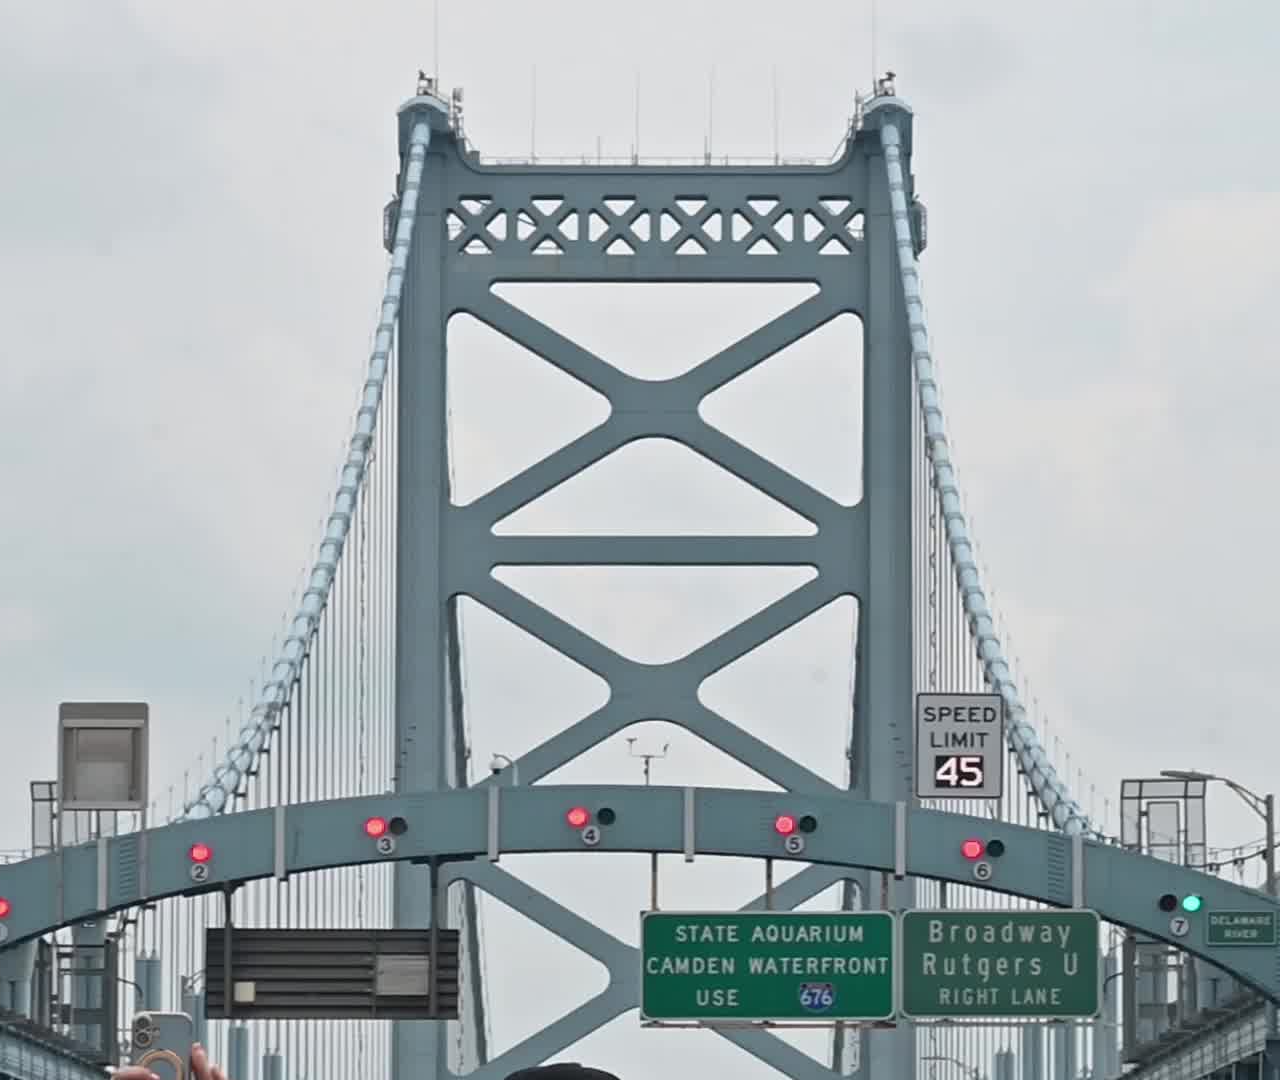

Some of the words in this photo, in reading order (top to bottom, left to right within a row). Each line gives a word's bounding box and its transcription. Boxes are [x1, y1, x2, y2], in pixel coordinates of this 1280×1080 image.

[923, 707, 997, 723] SPEED
[930, 732, 990, 748] LIMIT
[935, 757, 983, 787] 45
[675, 924, 739, 943] STATE
[751, 924, 864, 943] AQUARIUM
[928, 919, 1071, 949] Broadway
[645, 956, 735, 975] CAMDEN
[748, 956, 890, 975] WATERFRONT
[922, 952, 1042, 983] Rutgers
[1063, 952, 1078, 975] U
[696, 988, 739, 1007] USE
[799, 988, 833, 1007] 676
[939, 987, 999, 1006] RIGHT
[1011, 987, 1061, 1006] LANE
